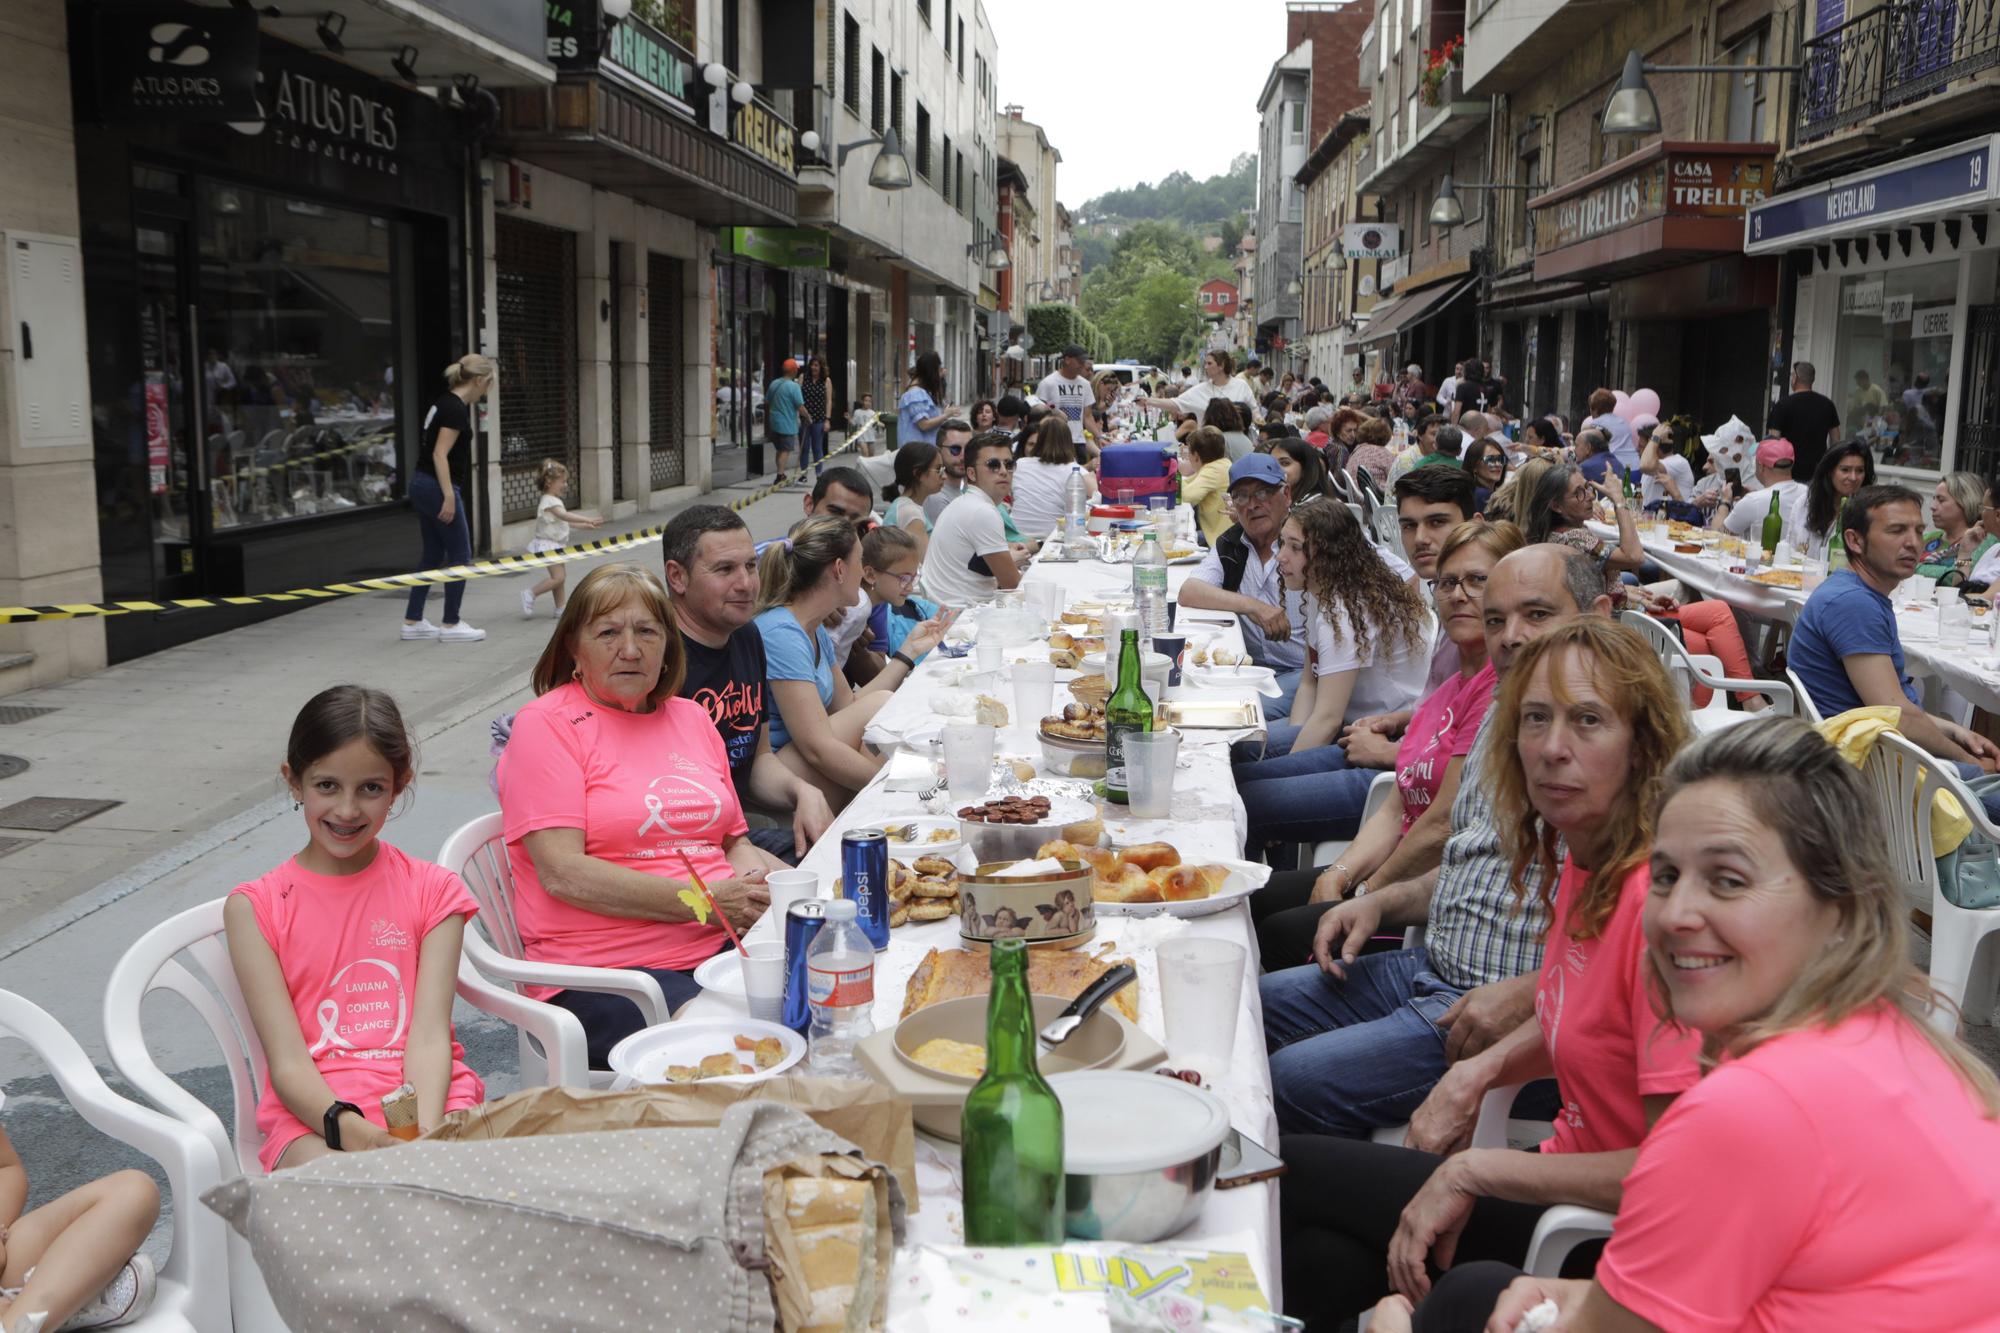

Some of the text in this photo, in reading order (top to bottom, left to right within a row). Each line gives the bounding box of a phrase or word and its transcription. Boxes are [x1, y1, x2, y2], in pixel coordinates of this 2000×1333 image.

[610, 22, 685, 101] ARMERIA
[181, 77, 221, 96] PIES
[348, 94, 397, 151] PIES
[1674, 161, 1713, 177] CASA
[1969, 155, 1982, 188] 19
[1673, 187, 1766, 206] TRELLES
[1827, 183, 1876, 220] NEVERLAND
[1579, 177, 1639, 237] TRELLES
[1754, 215, 1762, 239] 19
[1348, 249, 1396, 257] BUNKAI
[1890, 301, 1905, 320] POR
[1922, 313, 1949, 335] CIERRE
[1058, 384, 1084, 397] NYC
[855, 871, 874, 918] pepsi
[345, 980, 389, 994] LAVIANA
[346, 1000, 390, 1013] CONTRA
[340, 1024, 354, 1034] EL
